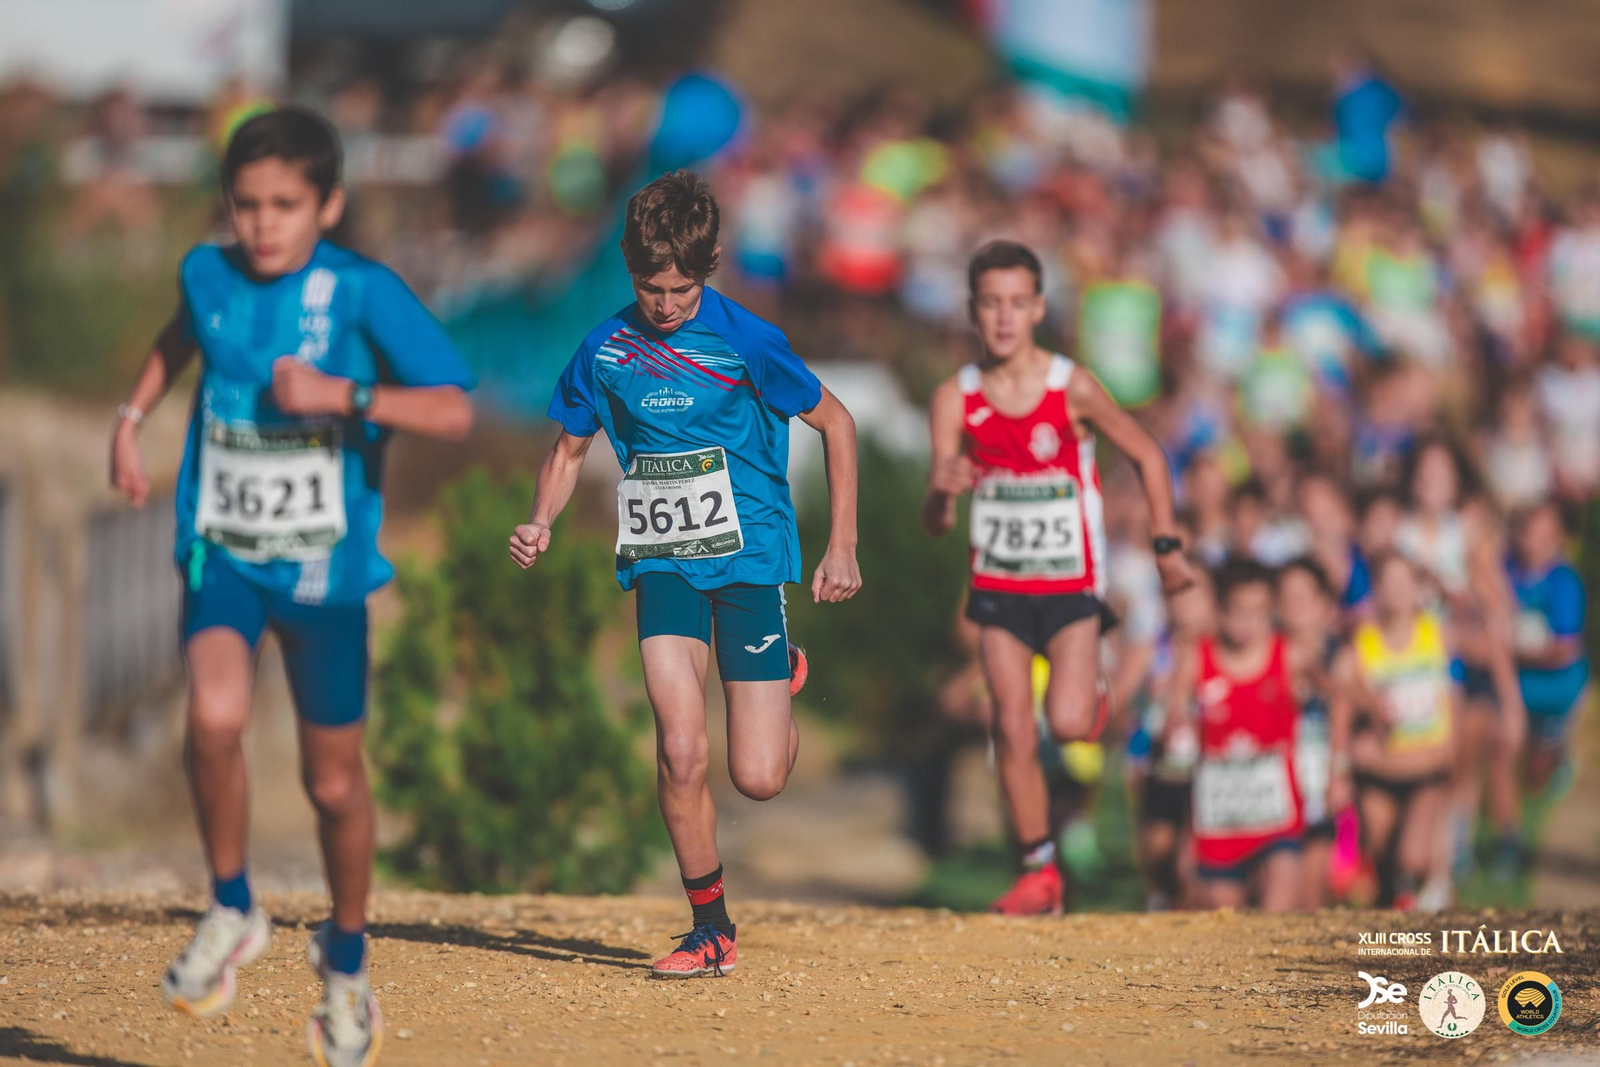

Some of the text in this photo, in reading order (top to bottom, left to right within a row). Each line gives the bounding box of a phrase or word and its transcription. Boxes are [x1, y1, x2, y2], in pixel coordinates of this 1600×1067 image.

[641, 397, 694, 407] CRONOS
[642, 457, 693, 473] ITÁLICA
[215, 471, 326, 522] 5621
[627, 490, 728, 535] 5612
[983, 516, 1072, 550] 7825
